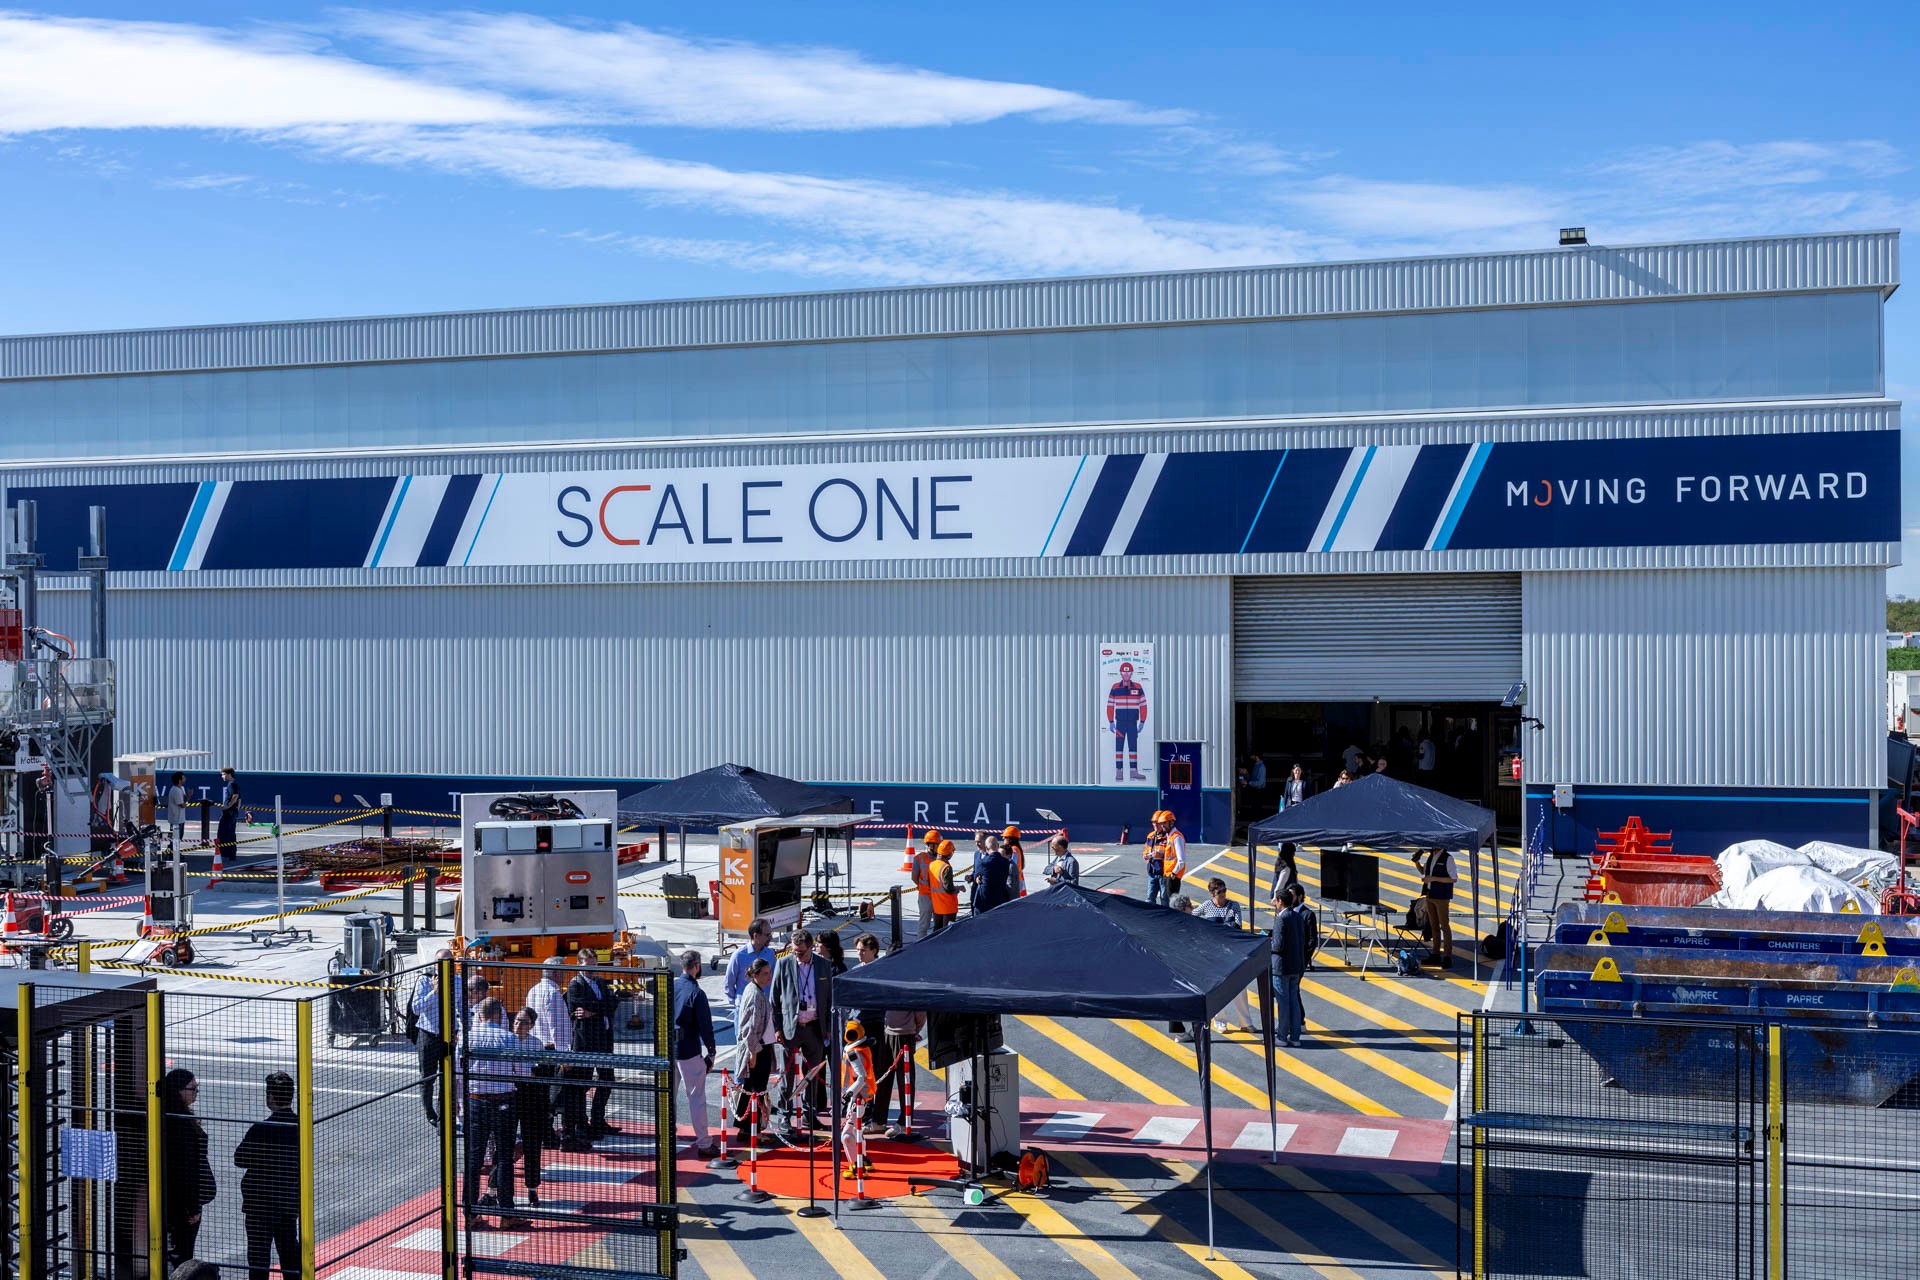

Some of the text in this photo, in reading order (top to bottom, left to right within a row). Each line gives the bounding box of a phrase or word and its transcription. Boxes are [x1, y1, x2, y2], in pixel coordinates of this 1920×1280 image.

[1507, 472, 1867, 507] MOVING FORWARD
[557, 475, 973, 547] SCALE ONE
[914, 801, 1020, 825] REAL
[724, 857, 749, 877] K-
[724, 877, 745, 886] BIM
[1673, 936, 1711, 946] PAPREC
[1767, 940, 1821, 950] CHANTIERS
[1682, 989, 1824, 1005] PAPREC PAPREC
